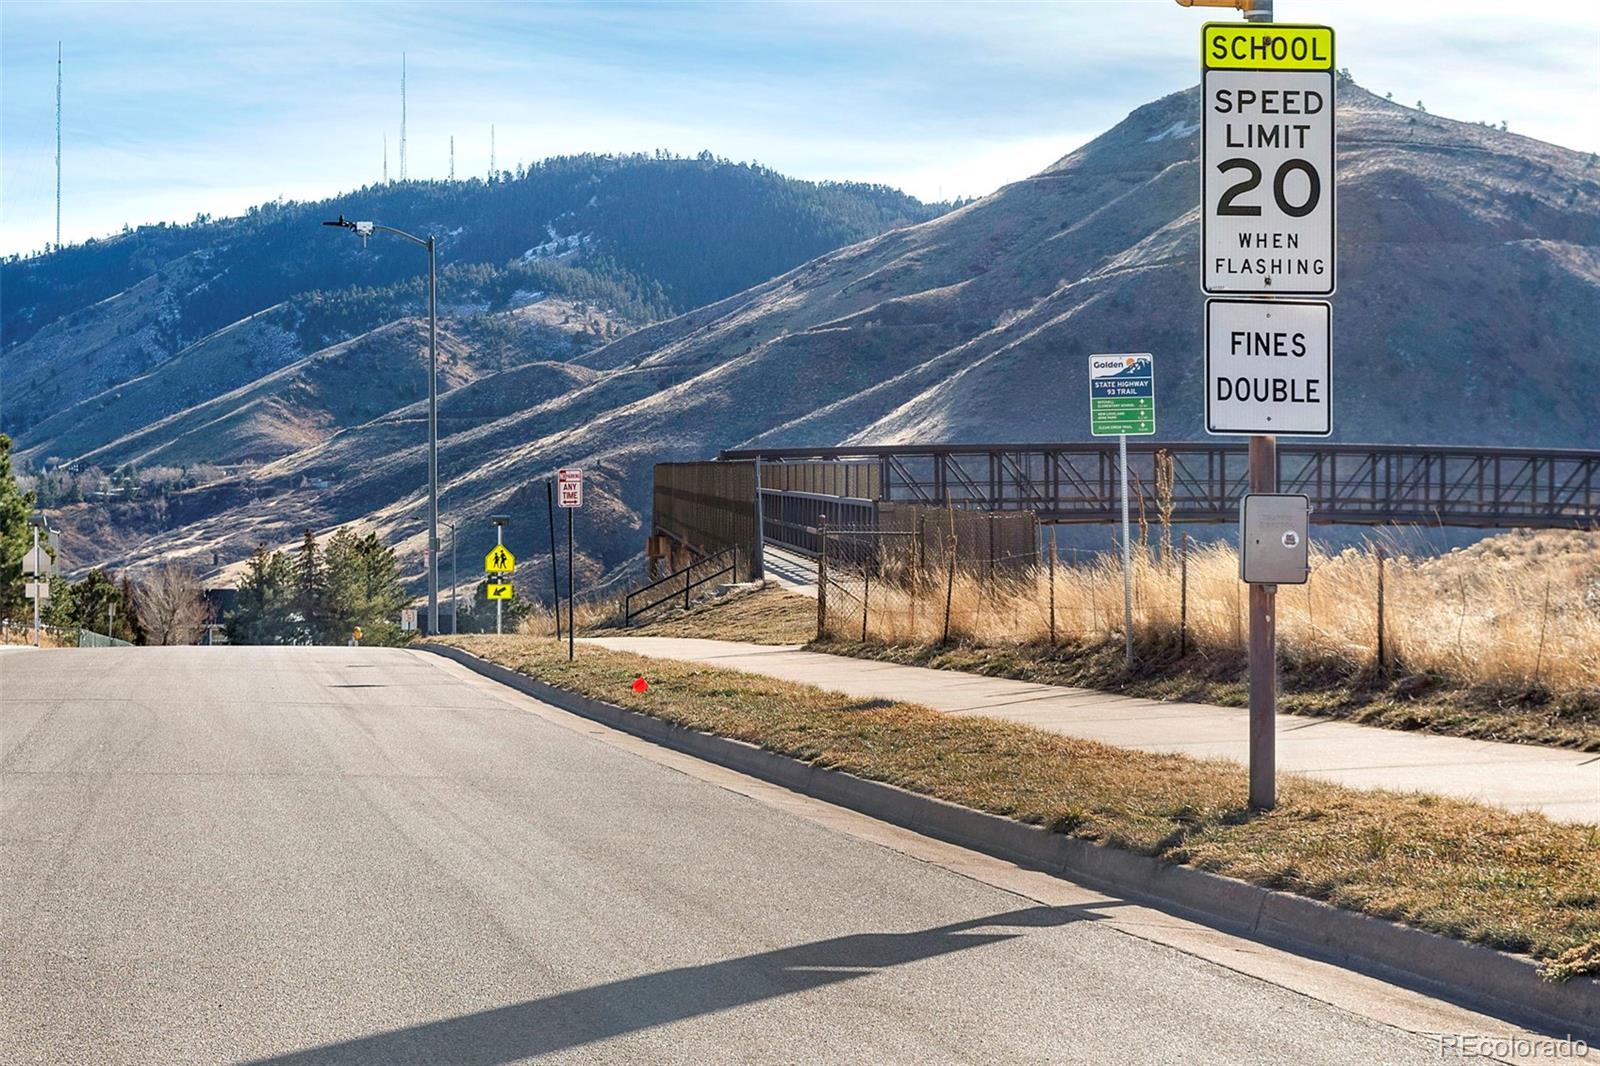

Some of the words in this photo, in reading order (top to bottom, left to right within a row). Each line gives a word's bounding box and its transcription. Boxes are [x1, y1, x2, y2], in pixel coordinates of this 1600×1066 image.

[1212, 35, 1327, 61] SCHOOL
[1214, 89, 1323, 115] SPEED
[1226, 123, 1311, 149] LIMIT
[1216, 157, 1321, 218] 20
[1238, 232, 1299, 249] WHEN
[1215, 257, 1324, 275] FLASHING
[1231, 331, 1306, 358] FINES
[1093, 361, 1124, 369] Golden
[1106, 388, 1116, 396] 93
[1117, 380, 1149, 388] HIGHWAY
[1217, 376, 1320, 403] DOUBLE
[562, 491, 578, 500] TIME
[563, 483, 577, 491] ANY
